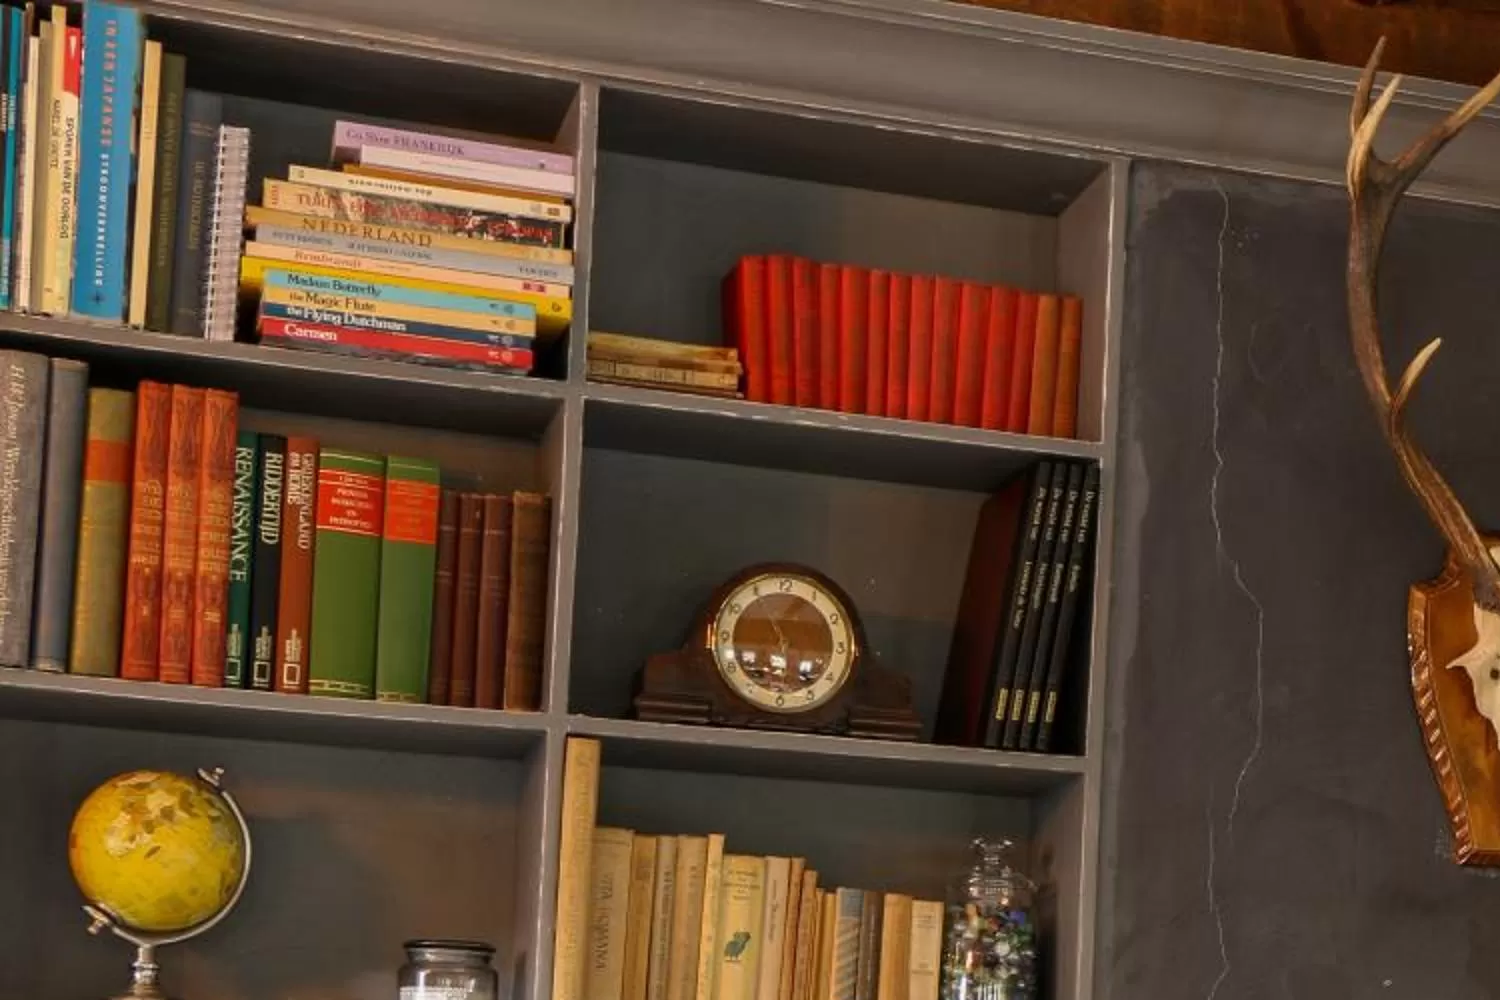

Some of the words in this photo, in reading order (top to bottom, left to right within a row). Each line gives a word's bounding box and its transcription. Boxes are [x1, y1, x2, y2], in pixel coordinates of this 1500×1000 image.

[100, 77, 115, 146] JAPANSE
[302, 217, 432, 248] NEDERLAND
[289, 292, 304, 301] the
[305, 292, 341, 309] Magic
[345, 297, 376, 311] Flute
[332, 279, 383, 298] Butterfly
[283, 323, 338, 342] Carmen
[286, 306, 302, 316] the
[303, 308, 342, 325] Flying
[343, 312, 407, 332] Dutchman
[260, 452, 284, 545] RIDDERTIJD
[287, 468, 302, 505] ROME
[296, 453, 316, 549] GRIEKENLAND
[228, 447, 256, 583] RENAISSANCE
[780, 580, 792, 592] 12
